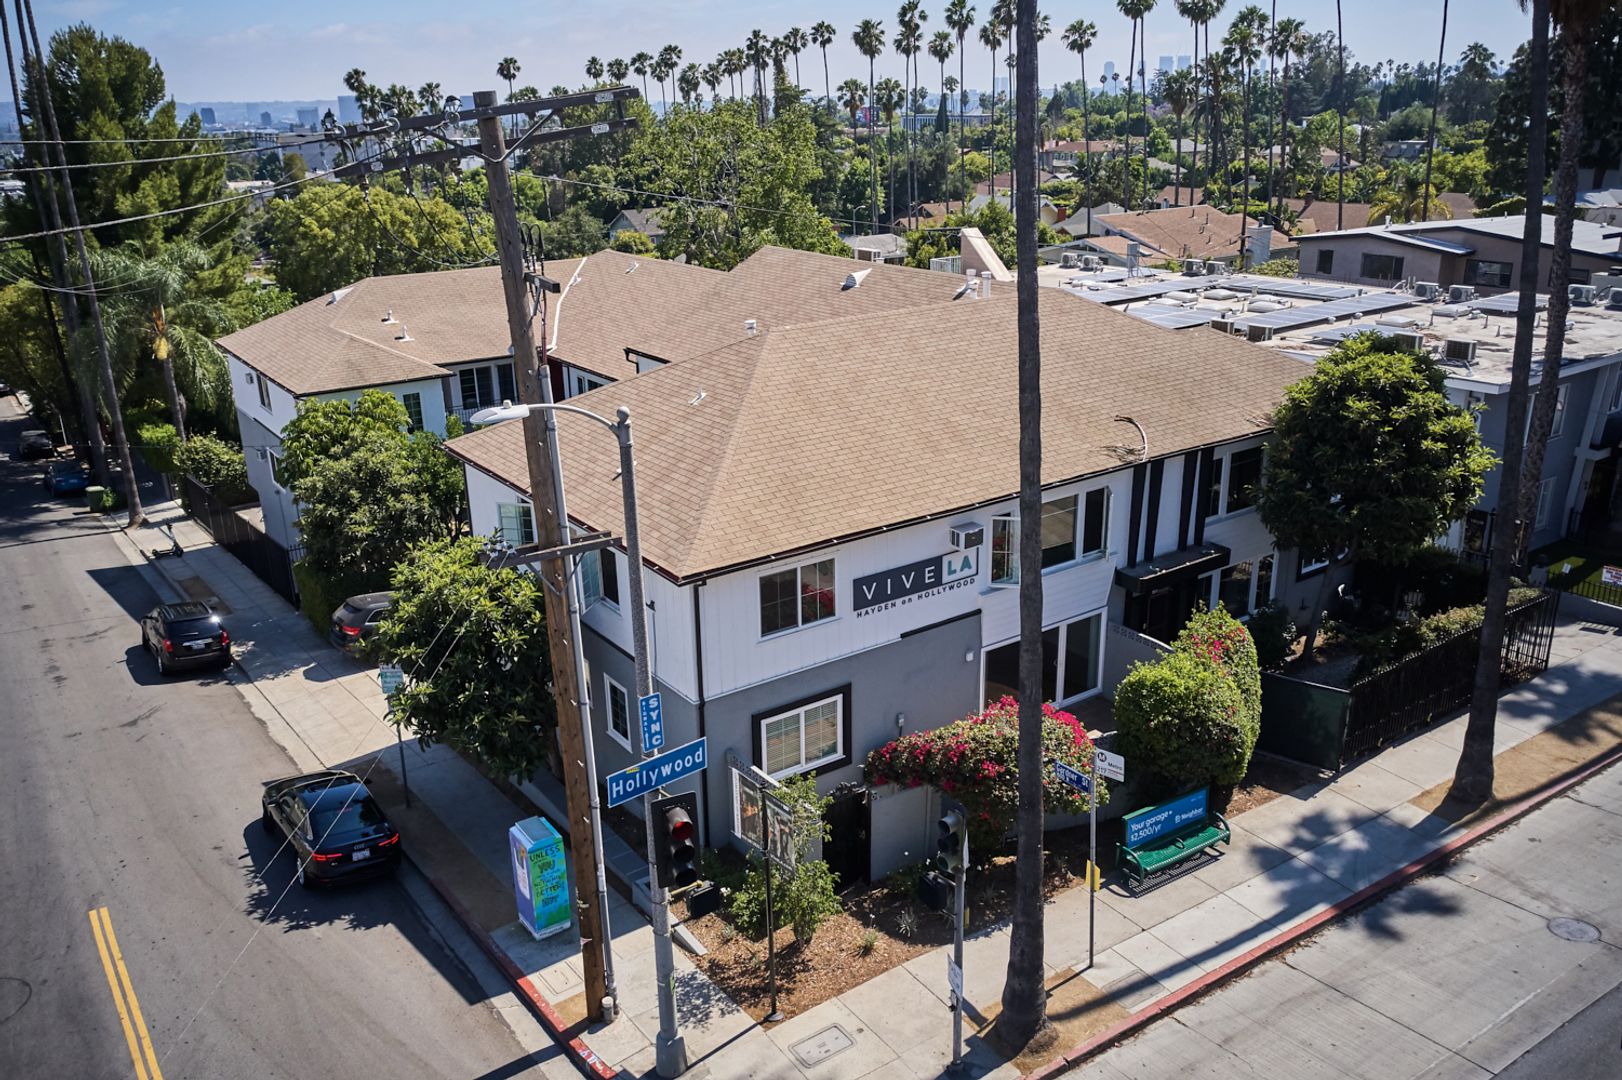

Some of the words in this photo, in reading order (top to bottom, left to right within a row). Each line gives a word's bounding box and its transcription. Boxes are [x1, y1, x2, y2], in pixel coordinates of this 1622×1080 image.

[862, 566, 936, 600] VIVE
[947, 555, 973, 576] LA
[856, 601, 897, 618] HAYDEN
[901, 597, 913, 605] on
[917, 578, 976, 600] HOLLYWOOD
[648, 697, 662, 745] SYNC
[612, 747, 703, 798] Hollywood
[1081, 777, 1089, 788] St
[1131, 821, 1145, 832] Your
[1145, 811, 1169, 827] garage
[1181, 807, 1203, 820] Neighbor
[529, 845, 561, 862] UNLESS
